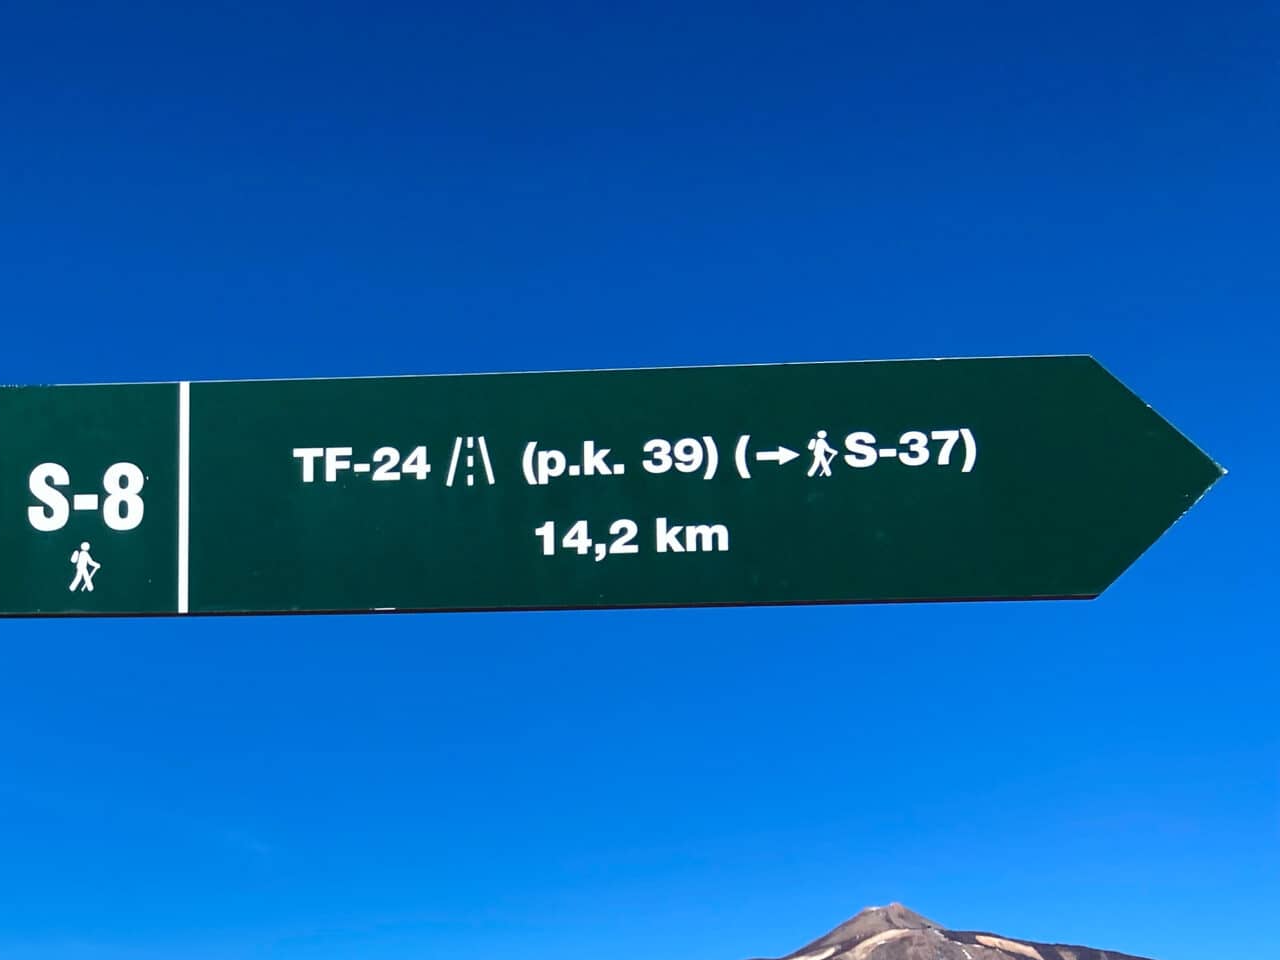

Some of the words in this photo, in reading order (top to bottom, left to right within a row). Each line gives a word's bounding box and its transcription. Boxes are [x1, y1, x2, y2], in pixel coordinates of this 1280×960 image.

[292, 445, 432, 483] TF-24
[522, 440, 626, 485] (p.k.
[642, 435, 719, 480] 39)
[27, 461, 145, 532] S-8
[534, 517, 639, 562] 14,2
[655, 517, 729, 553] km
